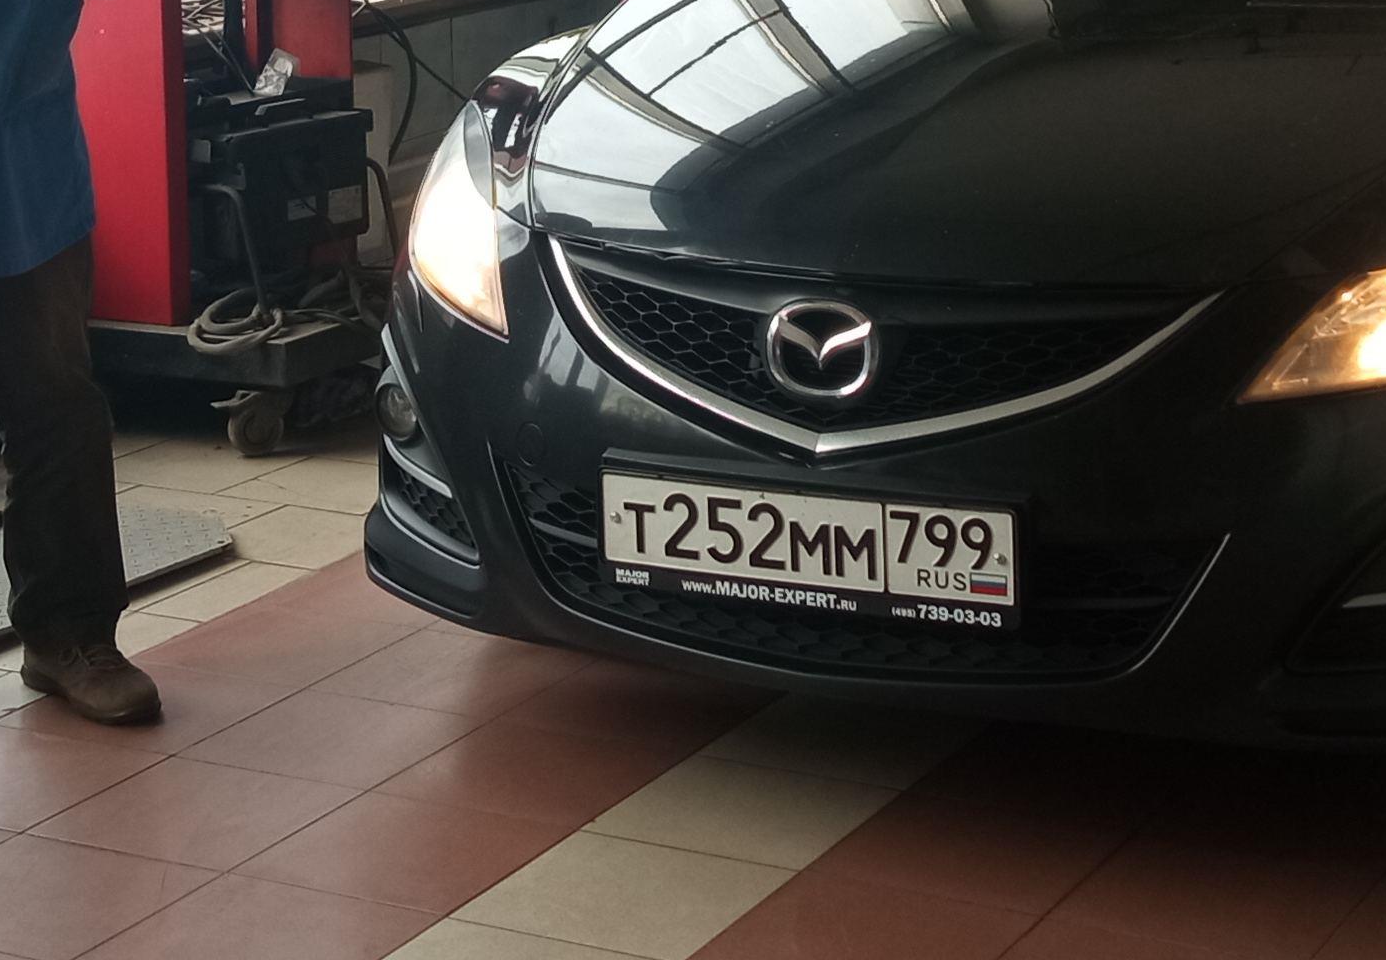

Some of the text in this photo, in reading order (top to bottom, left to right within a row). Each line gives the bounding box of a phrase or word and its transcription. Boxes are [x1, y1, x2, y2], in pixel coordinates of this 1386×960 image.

[623, 493, 994, 581] Т252ММ 799
[615, 567, 650, 578] MAJOR
[916, 568, 968, 592] RUS
[917, 604, 1002, 627] 739-03-03
